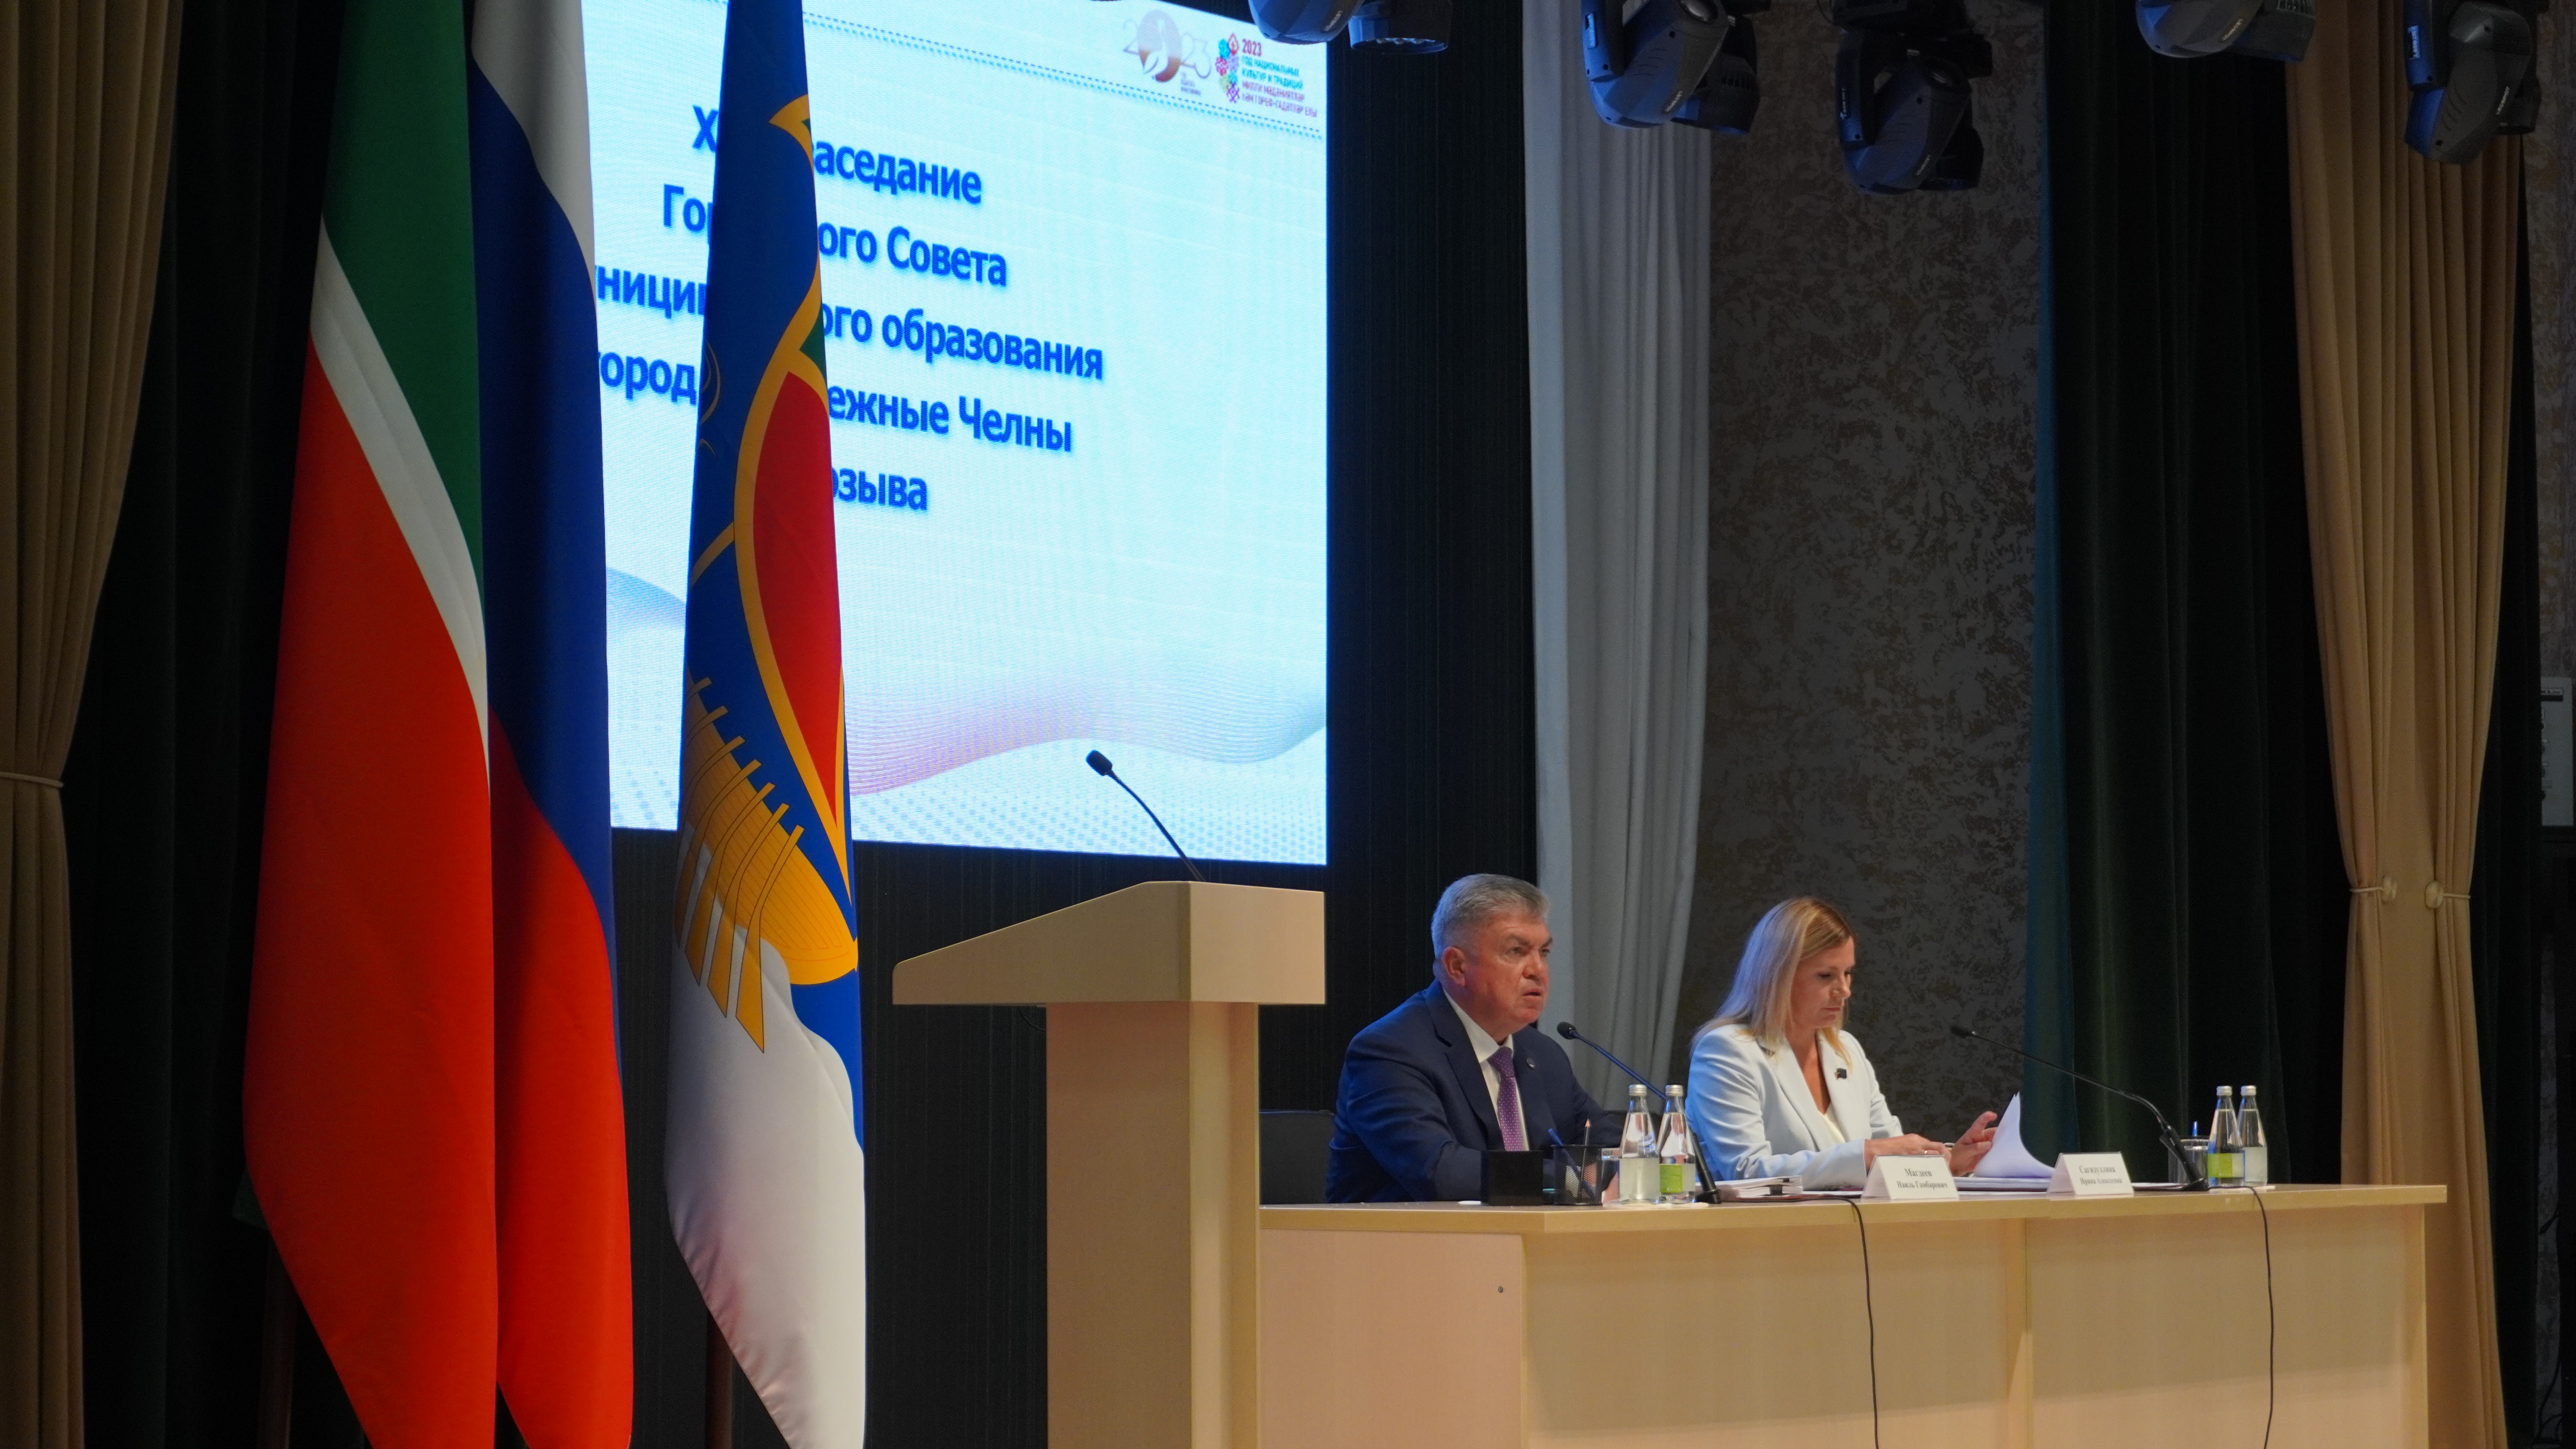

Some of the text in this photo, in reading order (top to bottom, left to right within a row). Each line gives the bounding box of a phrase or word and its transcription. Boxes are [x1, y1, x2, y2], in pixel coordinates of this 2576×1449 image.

[1242, 39, 1261, 57] 2023
[813, 141, 982, 205] аседание
[887, 226, 1007, 287] Совета
[882, 308, 1103, 380] образования
[598, 352, 1071, 452] ород ежные Челны
[832, 467, 927, 511] зыва
